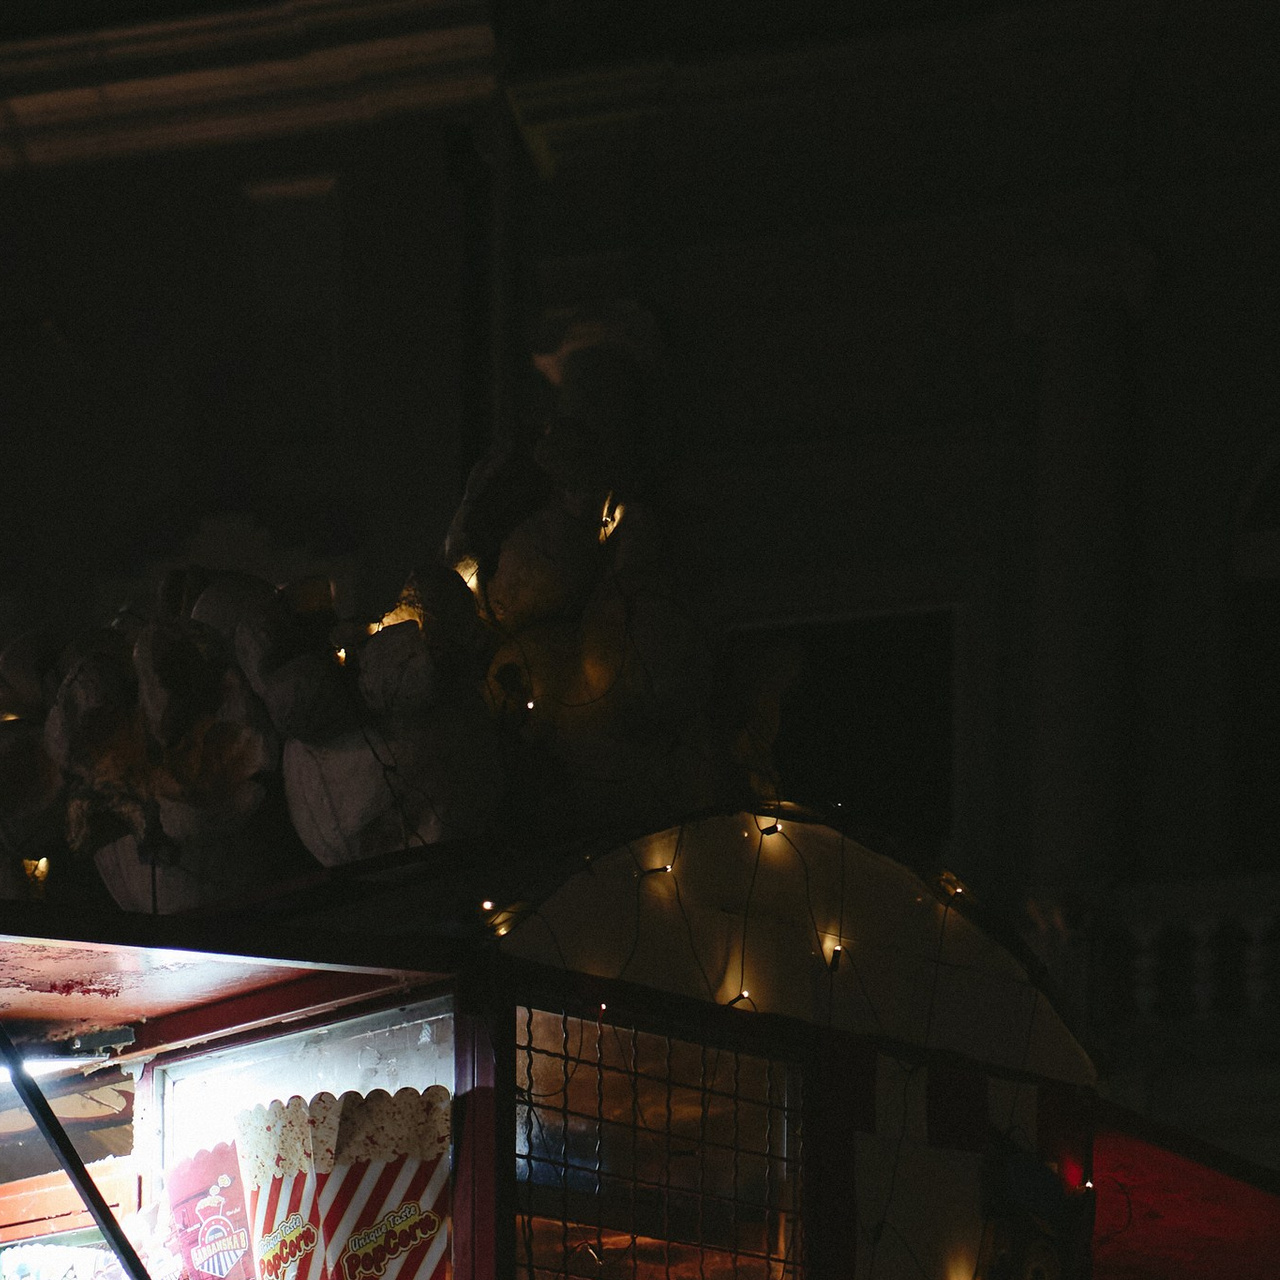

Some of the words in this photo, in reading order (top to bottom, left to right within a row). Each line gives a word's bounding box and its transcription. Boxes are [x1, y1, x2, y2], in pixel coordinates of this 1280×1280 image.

[281, 1216, 301, 1236] Taste
[345, 1215, 436, 1280] PopCorn
[351, 1224, 388, 1251] Unique
[388, 1205, 416, 1227] Taste
